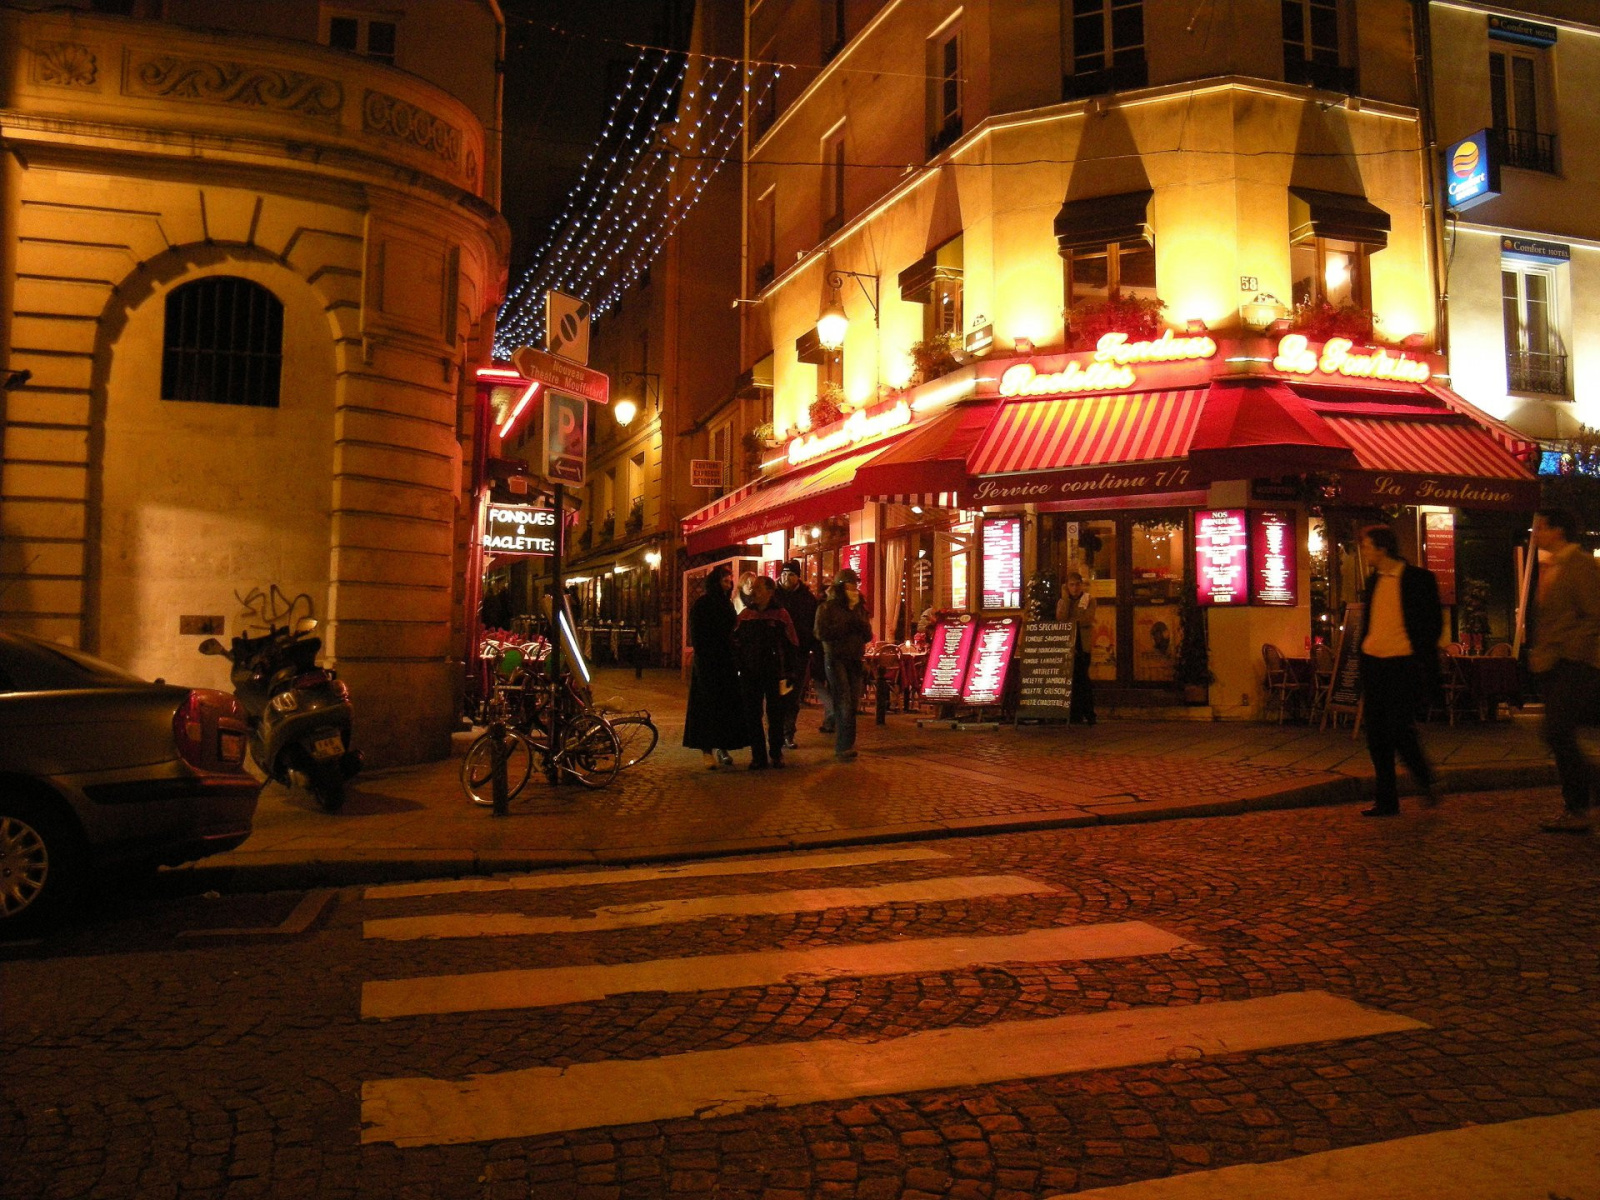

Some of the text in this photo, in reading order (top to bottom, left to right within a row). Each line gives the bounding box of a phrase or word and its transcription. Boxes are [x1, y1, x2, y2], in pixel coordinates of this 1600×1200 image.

[1500, 20, 1533, 35] Comfort
[1513, 241, 1569, 258] Comfort HOTEL
[1241, 277, 1258, 291] 58
[1094, 329, 1217, 363] Fondues
[1273, 334, 1431, 383] La Fontaine
[553, 360, 585, 381] Nouveau
[999, 363, 1136, 397] Raclettes
[564, 376, 604, 400] Mouffetard
[558, 405, 574, 446] P
[973, 466, 1191, 500] Service continu 7/7
[1371, 476, 1513, 502] La Fontaine
[489, 509, 555, 526] FONDUES
[1212, 511, 1229, 519] NOS
[517, 525, 526, 535] &
